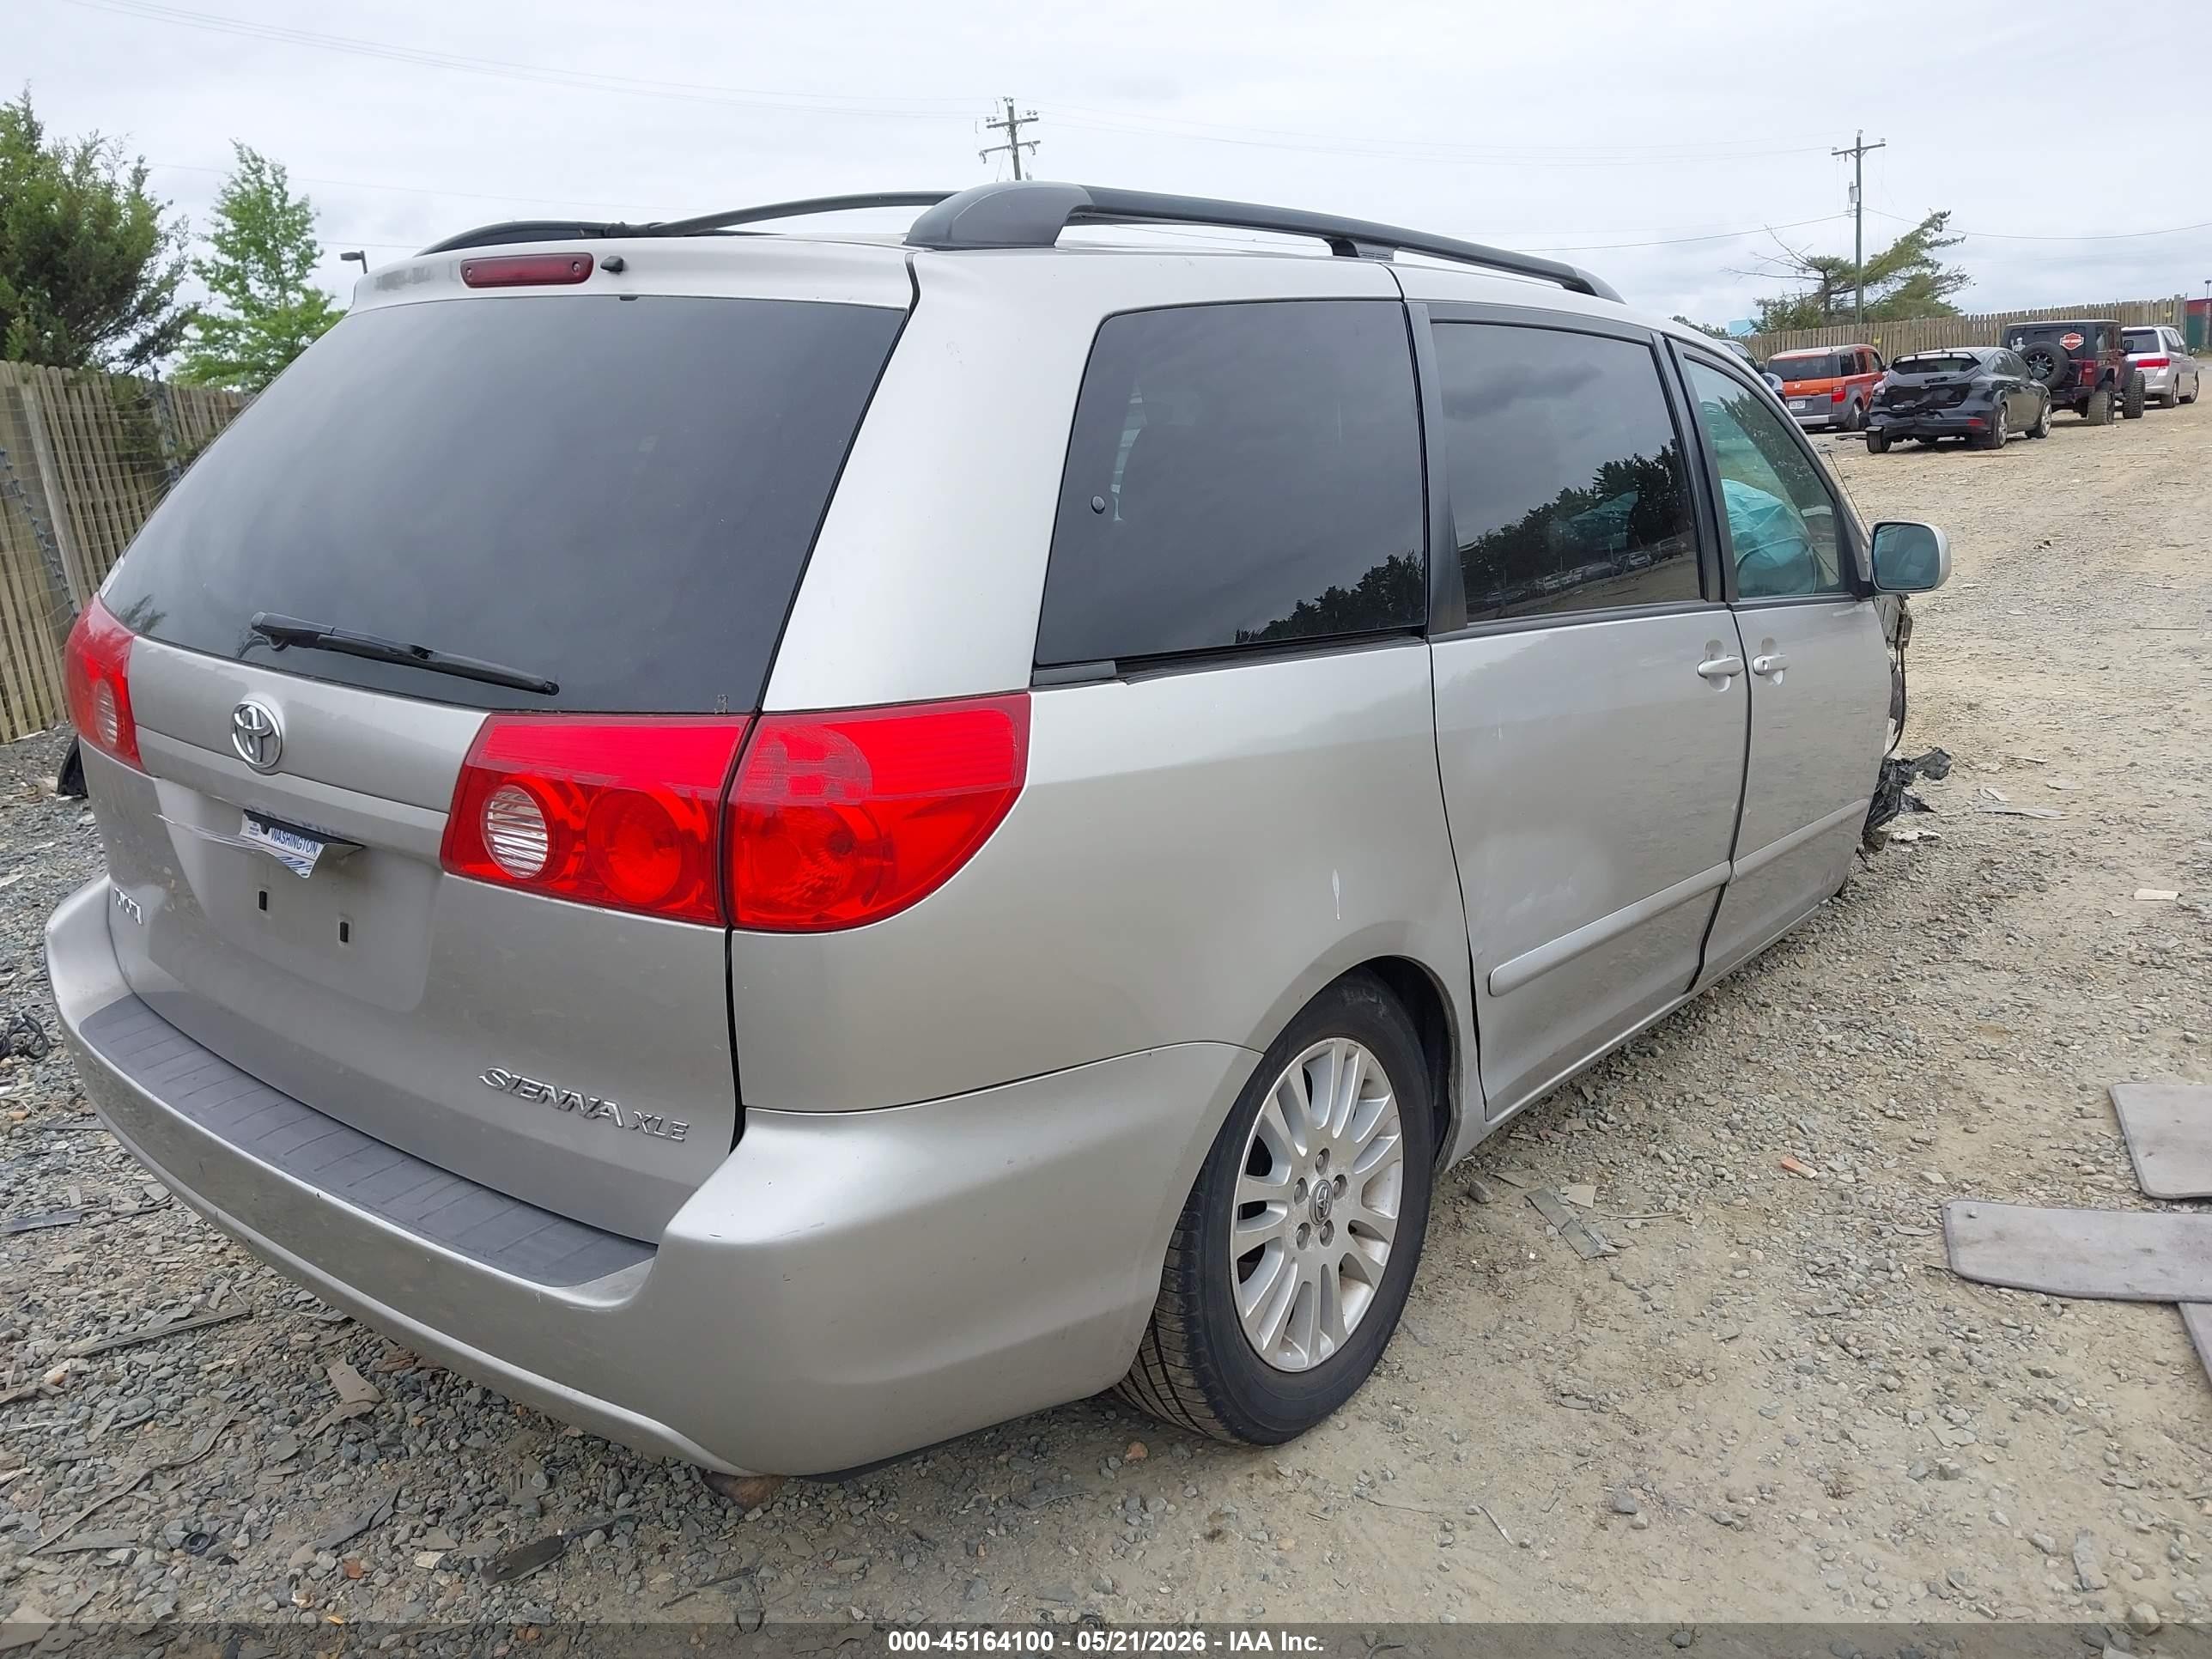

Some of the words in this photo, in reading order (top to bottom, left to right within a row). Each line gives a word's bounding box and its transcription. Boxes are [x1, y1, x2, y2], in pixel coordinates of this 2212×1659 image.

[270, 827, 318, 855] WASHINGTON
[477, 1066, 625, 1128] SIENNA
[628, 1109, 690, 1143] XLE
